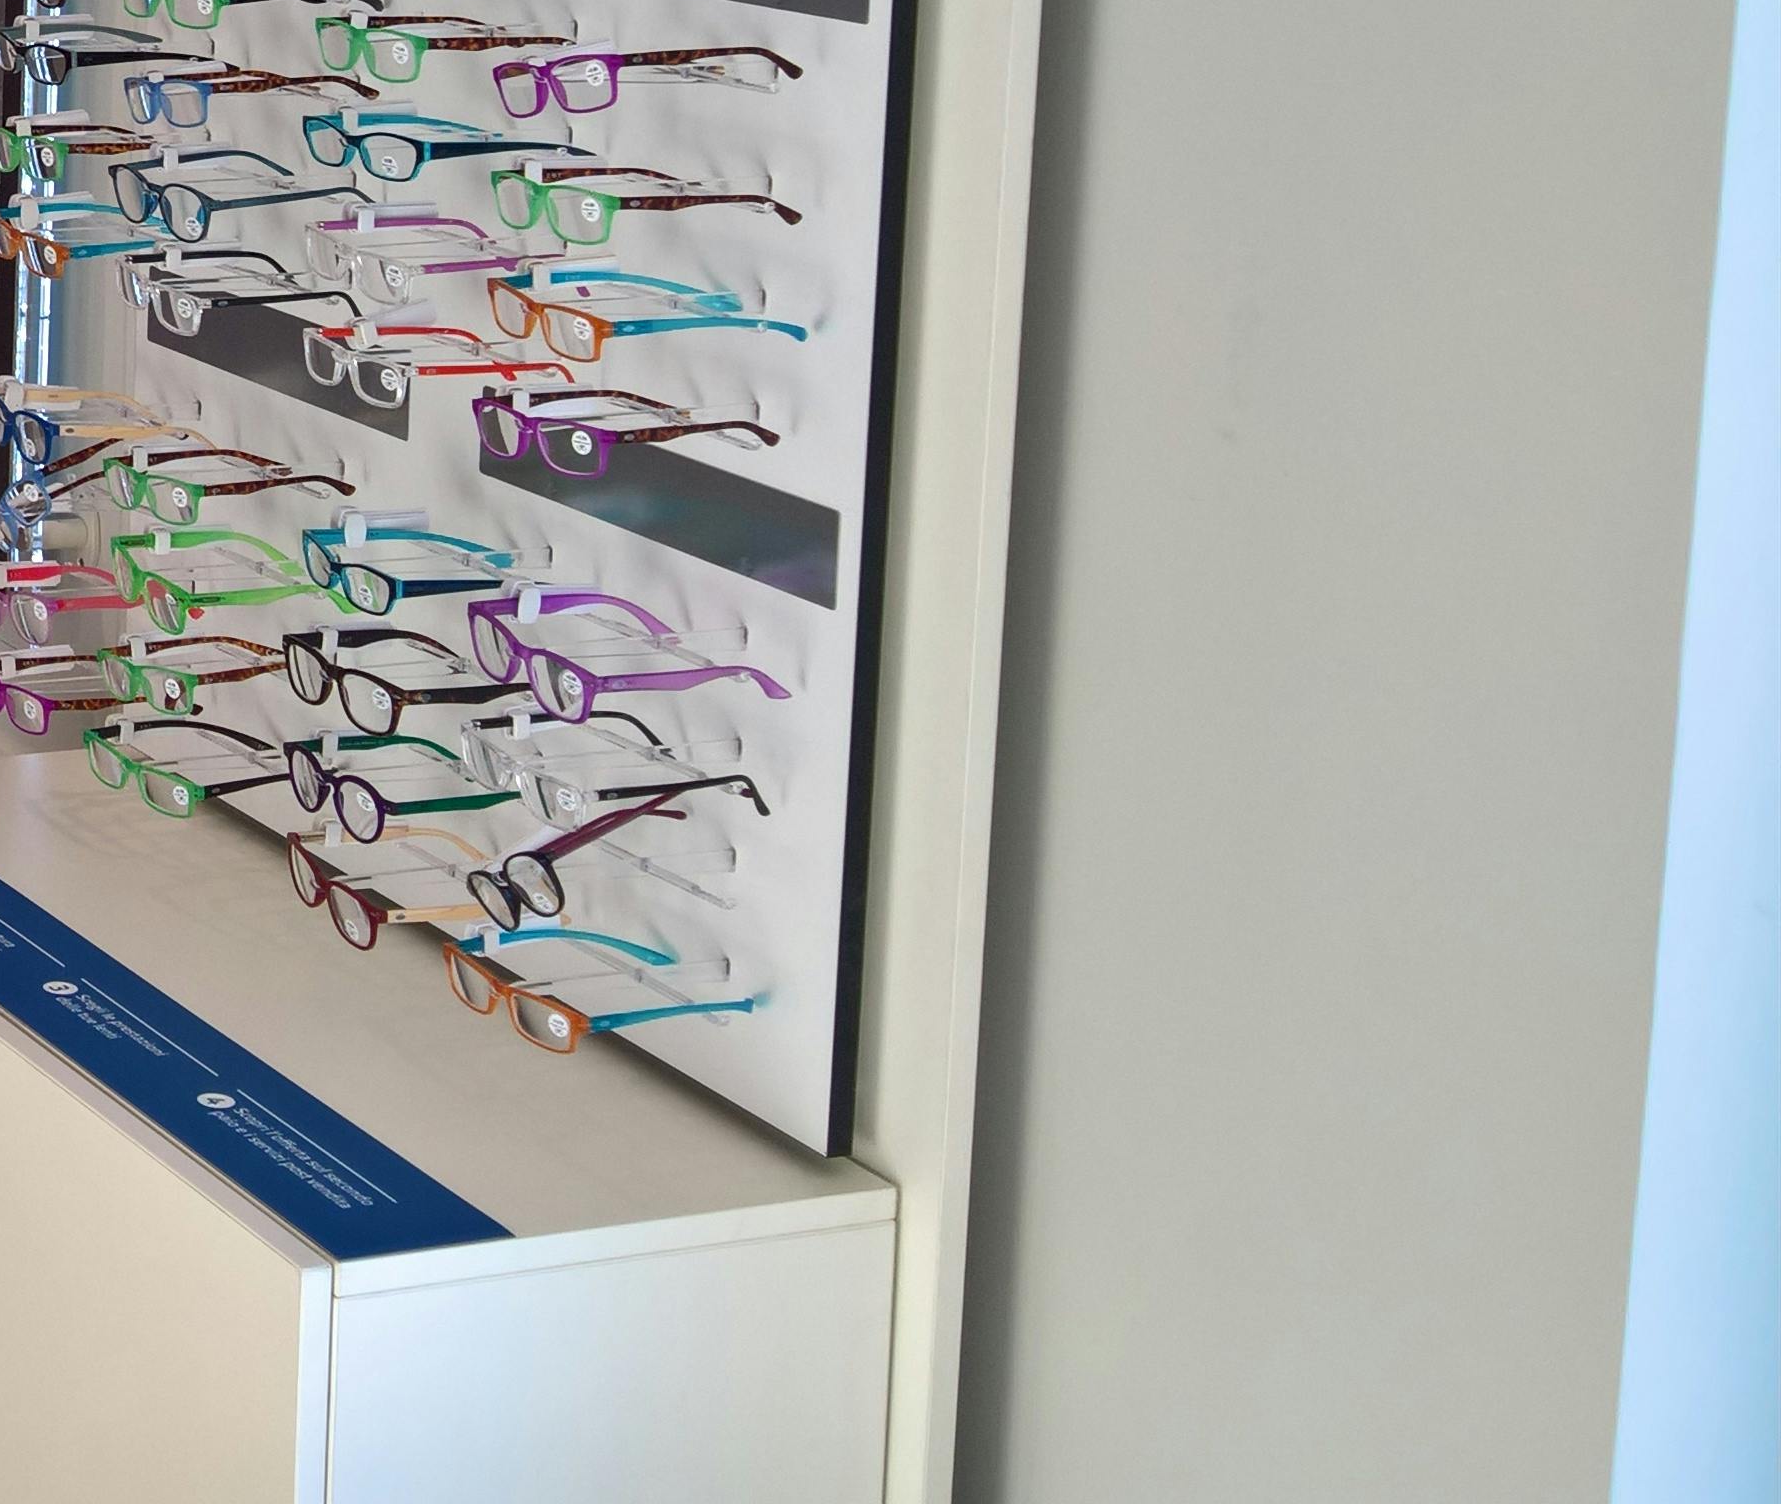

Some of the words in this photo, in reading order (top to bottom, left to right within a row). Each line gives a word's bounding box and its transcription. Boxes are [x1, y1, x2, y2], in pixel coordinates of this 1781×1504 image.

[93, 1024, 121, 1039] lenti
[107, 1021, 168, 1056] prestazioni
[208, 1111, 239, 1127] paio
[248, 1138, 289, 1161] servizi
[278, 1162, 312, 1179] post
[307, 1179, 351, 1208] vendita
[233, 1108, 273, 1131] Scopri
[266, 1131, 311, 1160] l'offerta
[306, 1161, 332, 1173] sul
[323, 1173, 373, 1205] secondo
